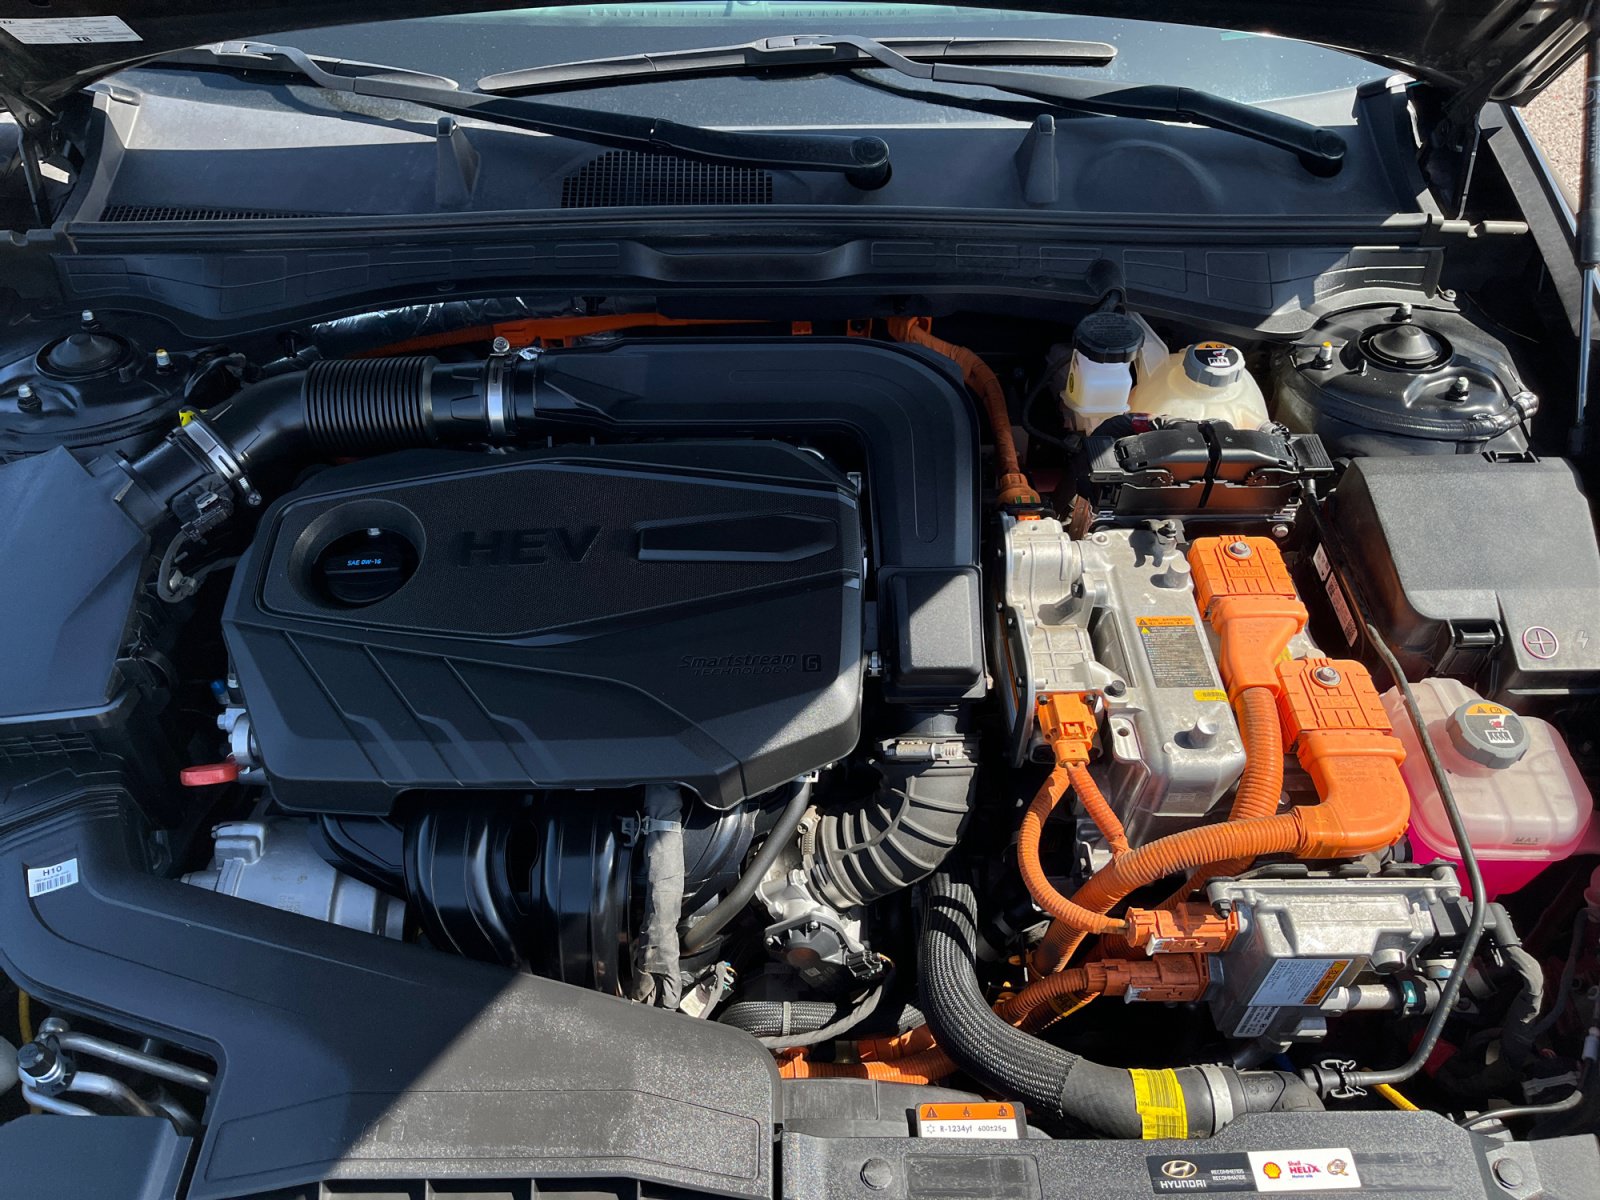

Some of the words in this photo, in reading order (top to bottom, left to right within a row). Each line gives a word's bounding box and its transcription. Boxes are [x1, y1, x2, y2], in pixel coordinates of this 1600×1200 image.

[456, 526, 603, 568] HEV
[679, 653, 797, 669] Smartstream
[693, 664, 793, 677] TECHNOLOGY
[43, 865, 62, 876] H10
[940, 1125, 972, 1133] R-1234yf
[977, 1125, 1007, 1133] 600±25g
[1289, 1165, 1321, 1174] HELIX
[1160, 1179, 1207, 1189] HYUNDAI
